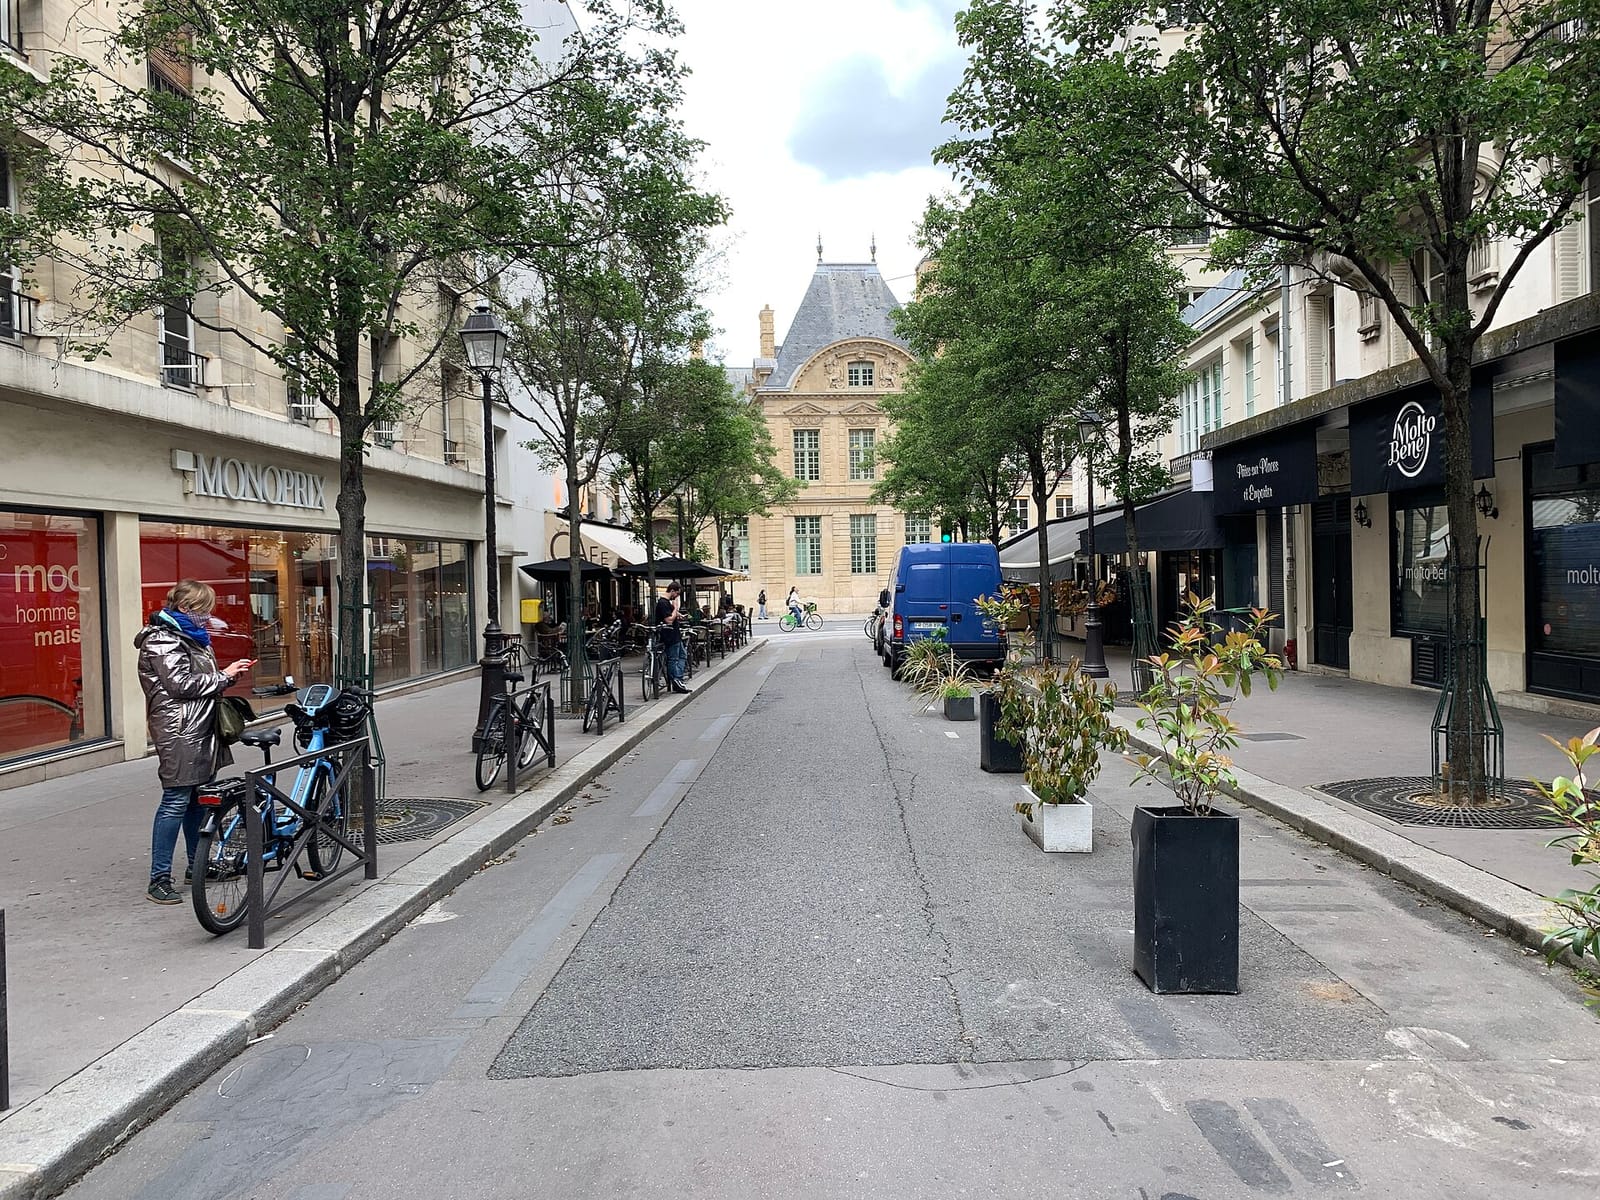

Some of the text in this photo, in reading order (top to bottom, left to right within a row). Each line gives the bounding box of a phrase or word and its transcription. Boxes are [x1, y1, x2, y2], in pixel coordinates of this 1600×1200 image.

[1396, 414, 1436, 445] Molto
[1387, 436, 1425, 467] Bene
[194, 452, 326, 509] MONOPRIX
[1567, 564, 1600, 584] molt
[15, 604, 77, 624] homme
[34, 624, 81, 647] mais
